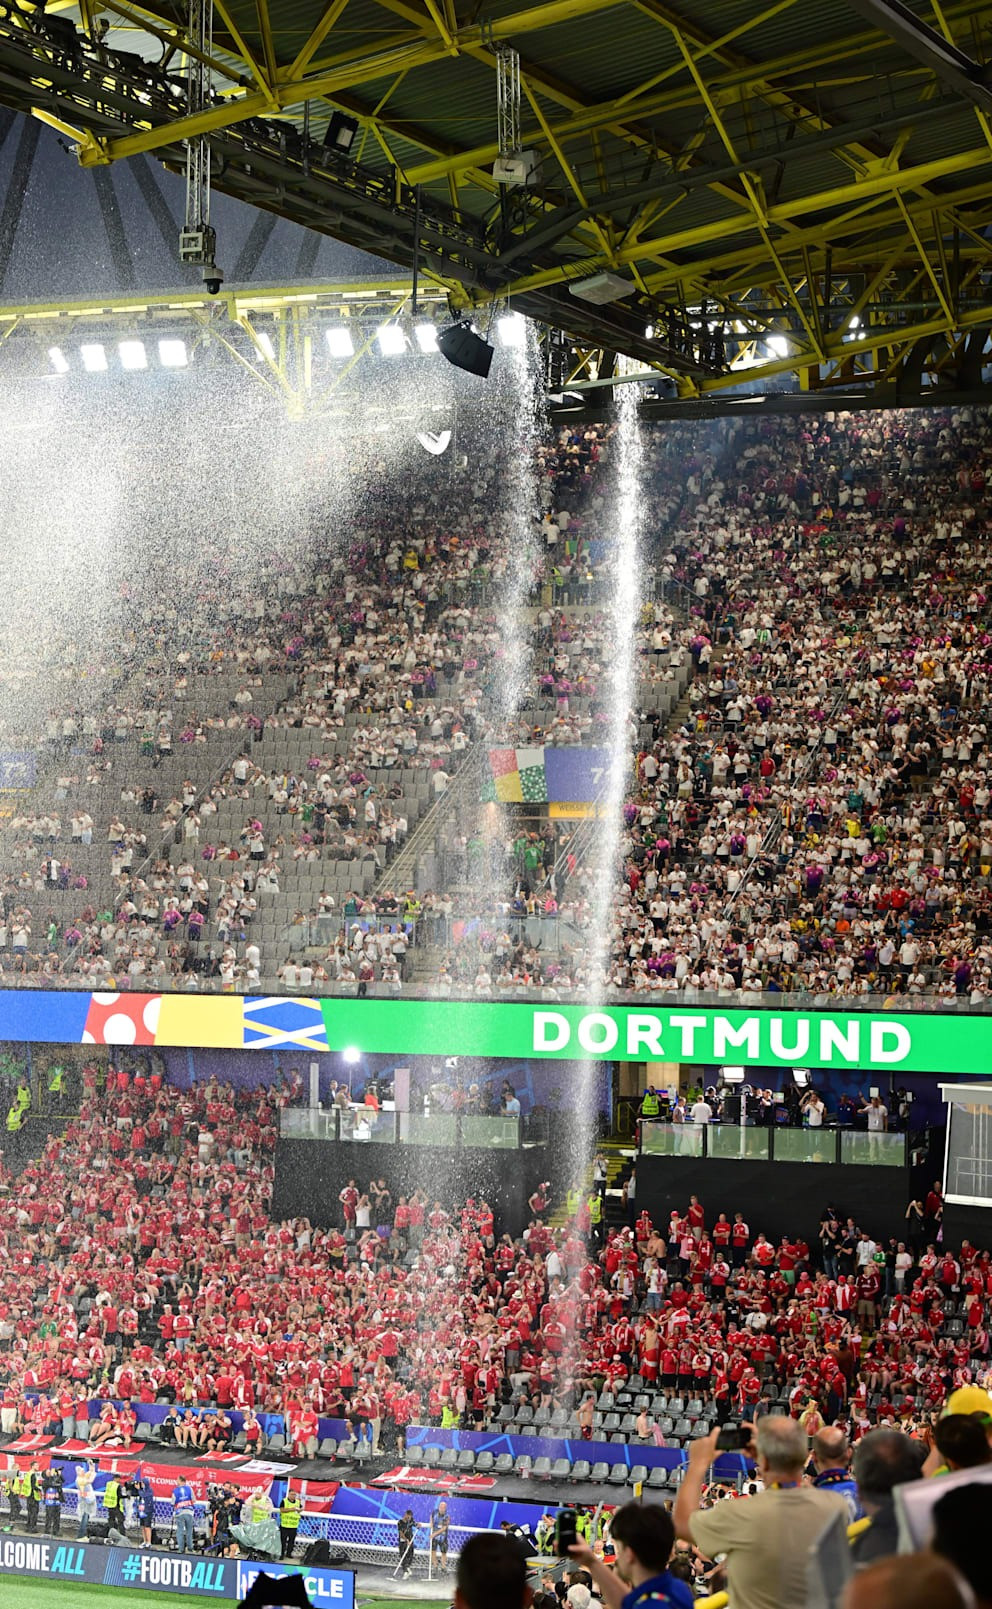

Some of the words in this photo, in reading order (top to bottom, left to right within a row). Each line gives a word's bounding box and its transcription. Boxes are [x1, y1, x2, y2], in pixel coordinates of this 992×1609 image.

[532, 1011, 912, 1063] DORTMUND
[50, 1546, 85, 1575] ALL
[121, 1554, 225, 1591] #FOOTBALL
